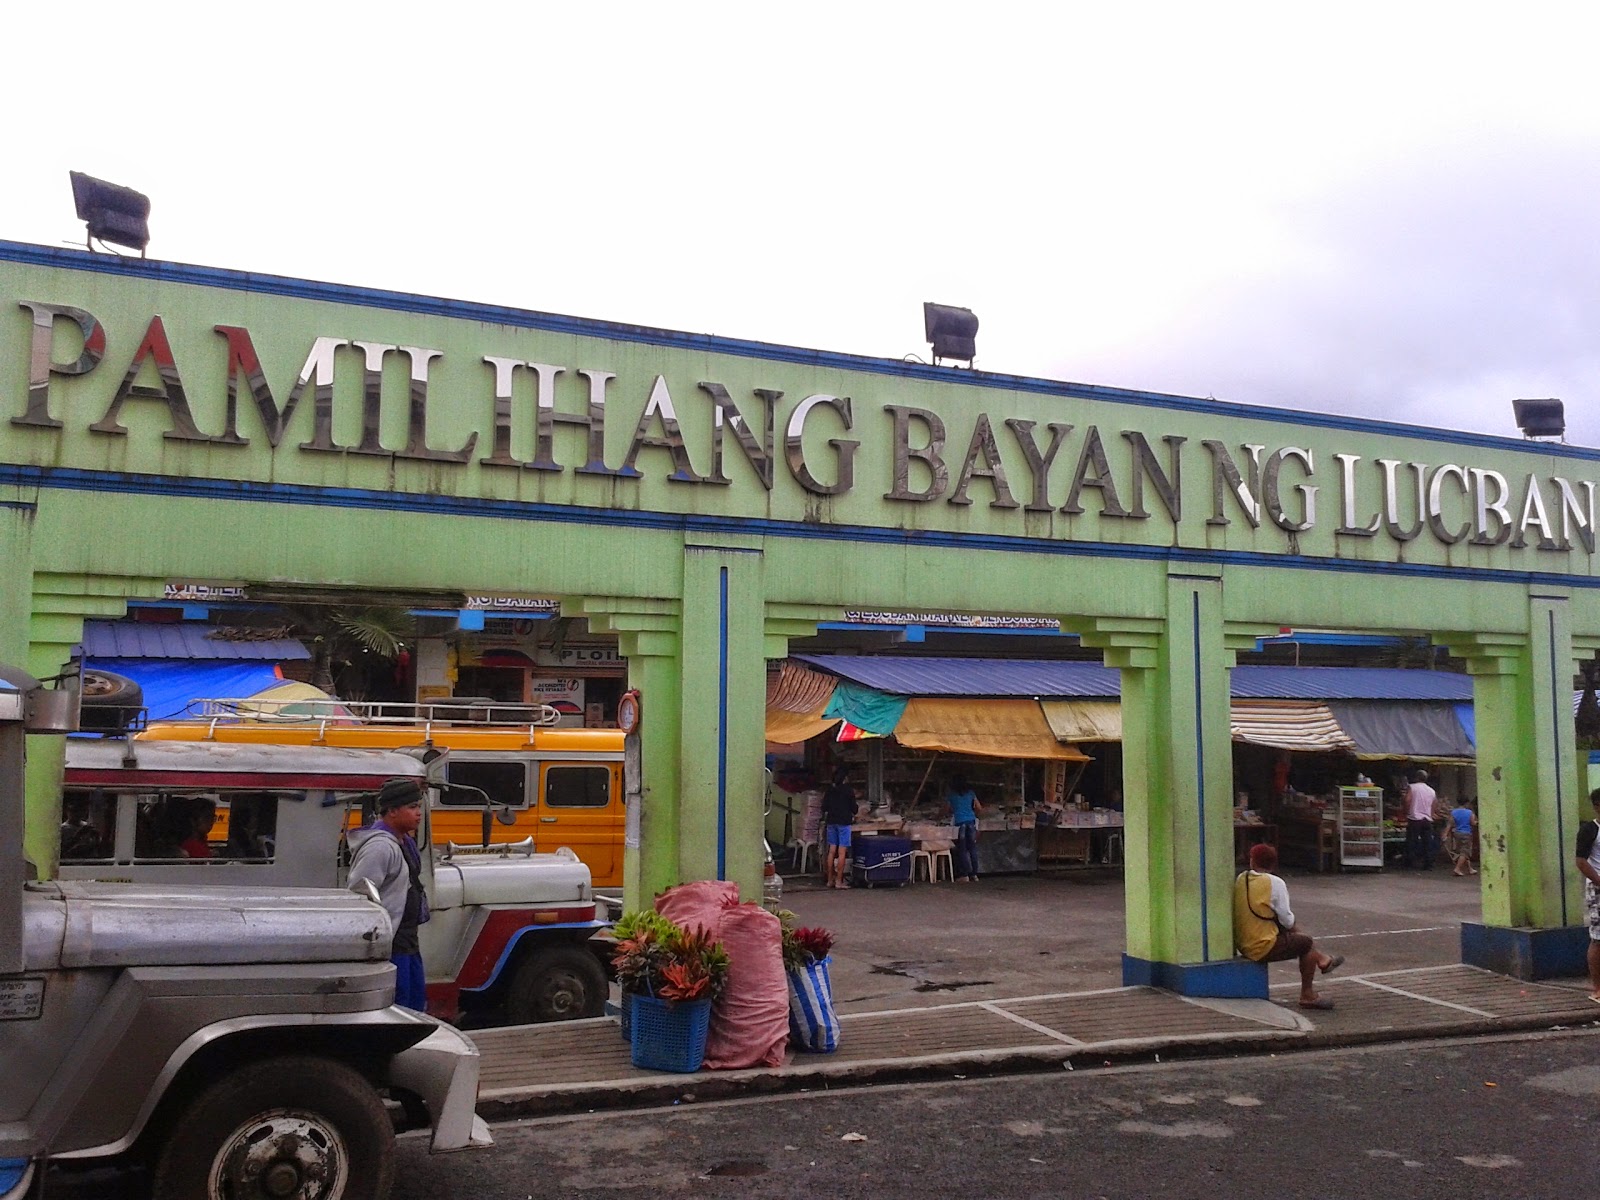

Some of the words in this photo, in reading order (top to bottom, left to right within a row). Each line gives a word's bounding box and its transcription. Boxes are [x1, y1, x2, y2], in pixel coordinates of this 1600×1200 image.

[11, 300, 860, 496] PAMILIHANG
[884, 404, 1187, 523] BAYAN
[1203, 440, 1320, 533] NG
[1333, 453, 1598, 554] LUCBAN
